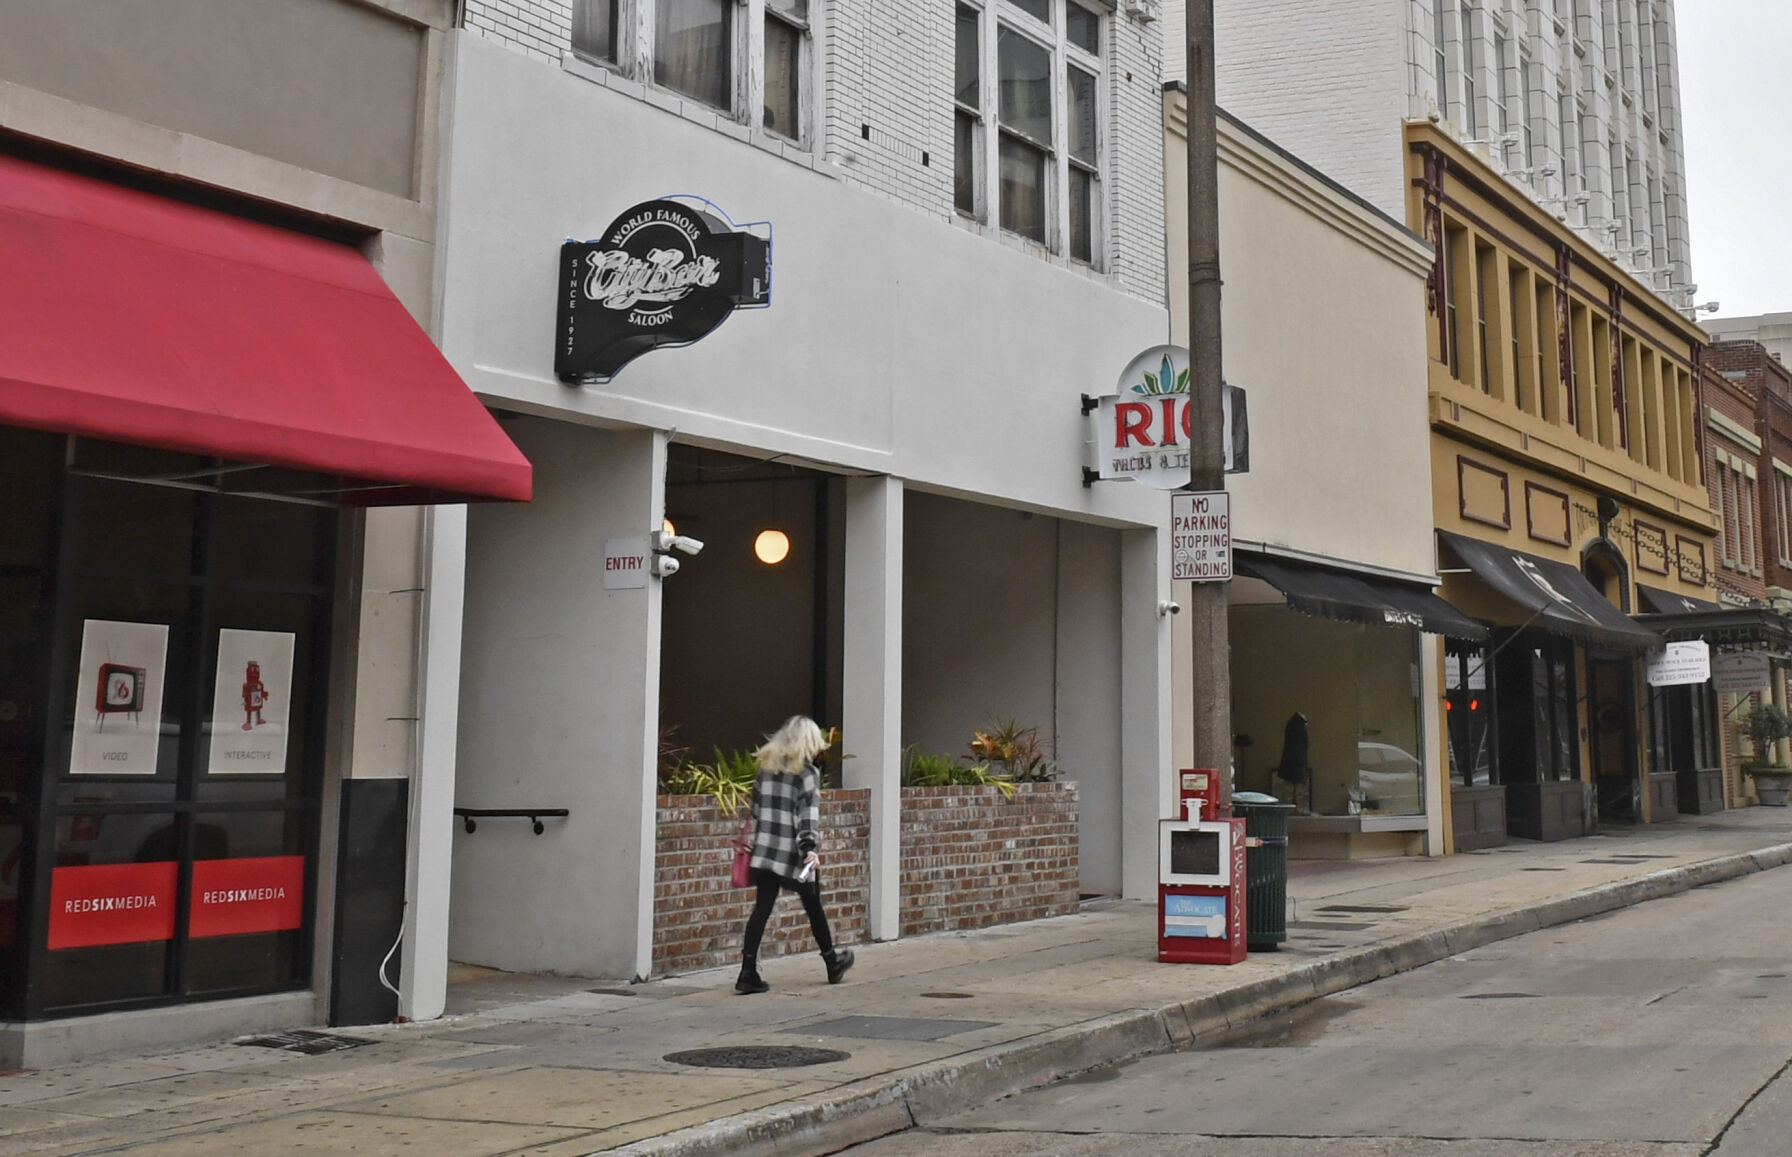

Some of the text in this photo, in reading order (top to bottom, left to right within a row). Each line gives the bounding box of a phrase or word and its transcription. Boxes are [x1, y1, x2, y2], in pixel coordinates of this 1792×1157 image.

[611, 209, 701, 246] WORLD FAMOUS
[569, 259, 578, 309] SINCE
[627, 311, 674, 326] SALOON
[567, 316, 575, 356] 1927
[1114, 397, 1224, 449] RI
[1192, 497, 1209, 514] NO
[1174, 514, 1228, 531] PARKING
[1174, 534, 1228, 549] STOPPING
[606, 556, 644, 571] ENTRY
[1195, 550, 1207, 561] OR
[1175, 562, 1228, 577] STANDING
[102, 751, 128, 761] VIDEO
[223, 750, 272, 760] INTERACTIVE
[65, 894, 157, 913] REDSIXMEDIA
[203, 886, 286, 904] REDSIXMEDIA
